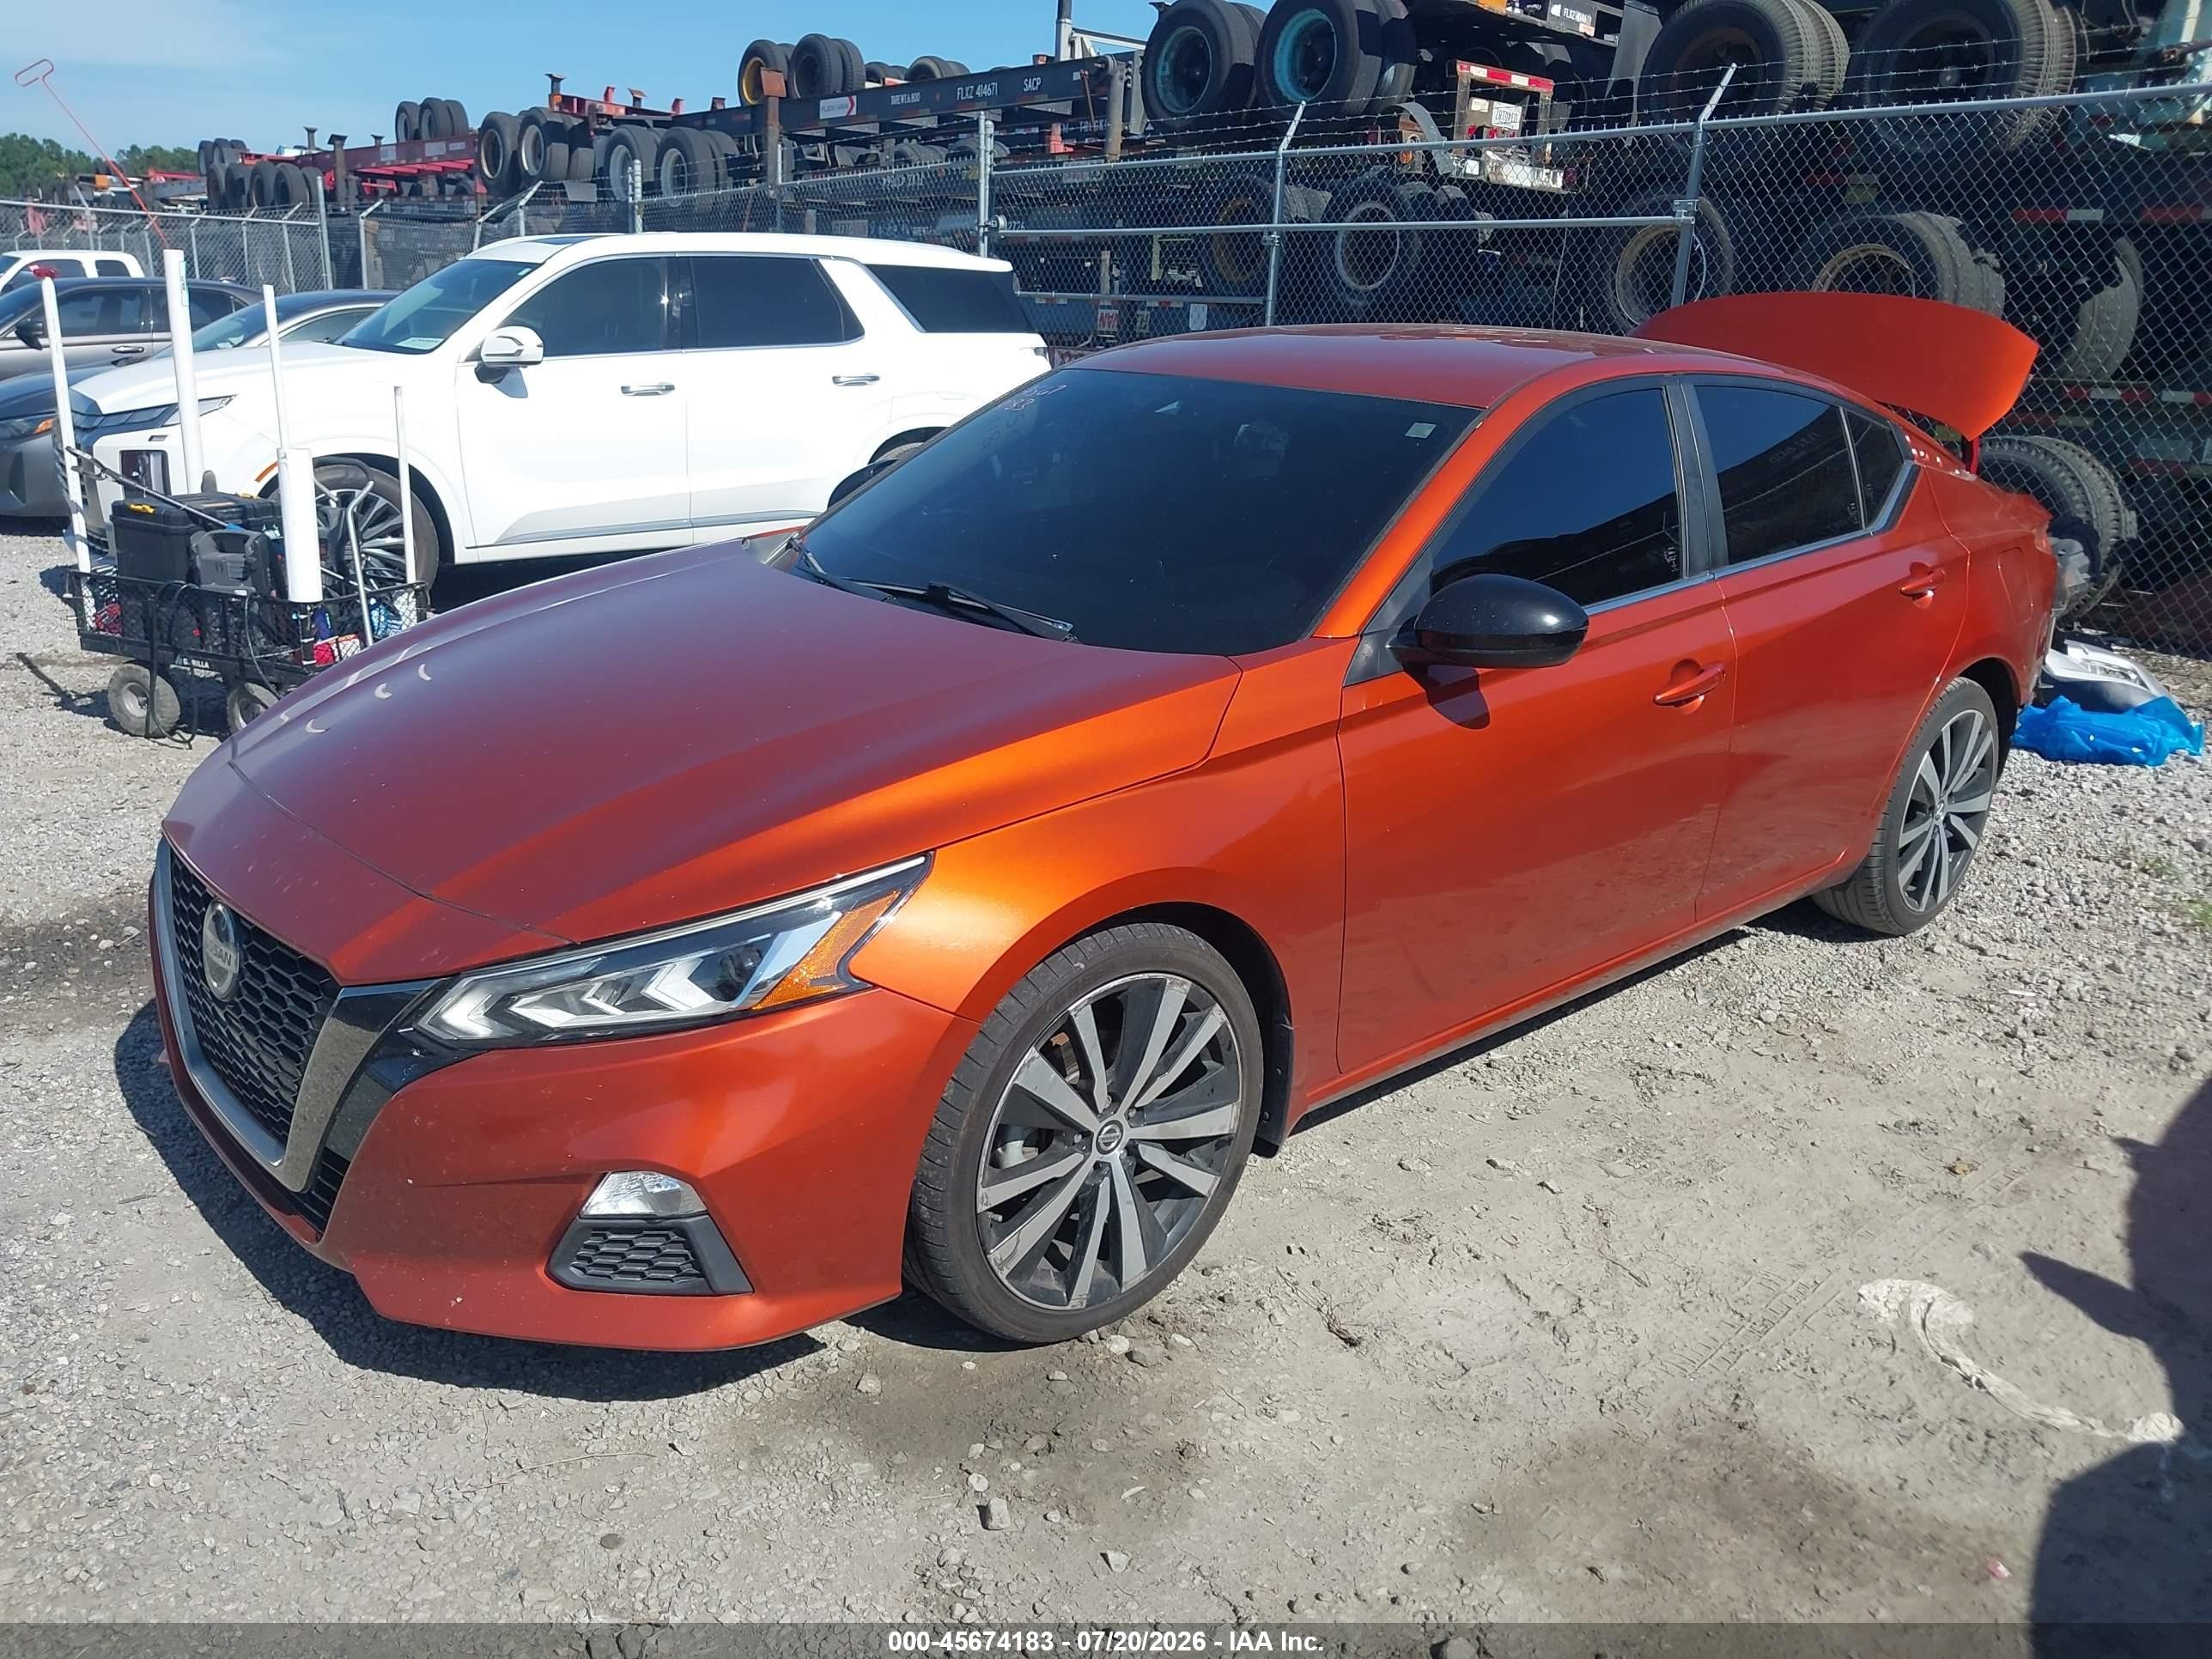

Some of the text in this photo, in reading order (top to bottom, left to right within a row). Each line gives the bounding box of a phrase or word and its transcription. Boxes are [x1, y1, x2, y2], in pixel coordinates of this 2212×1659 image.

[957, 82, 998, 101] FLXZ 414671
[1023, 77, 1042, 92] SACP
